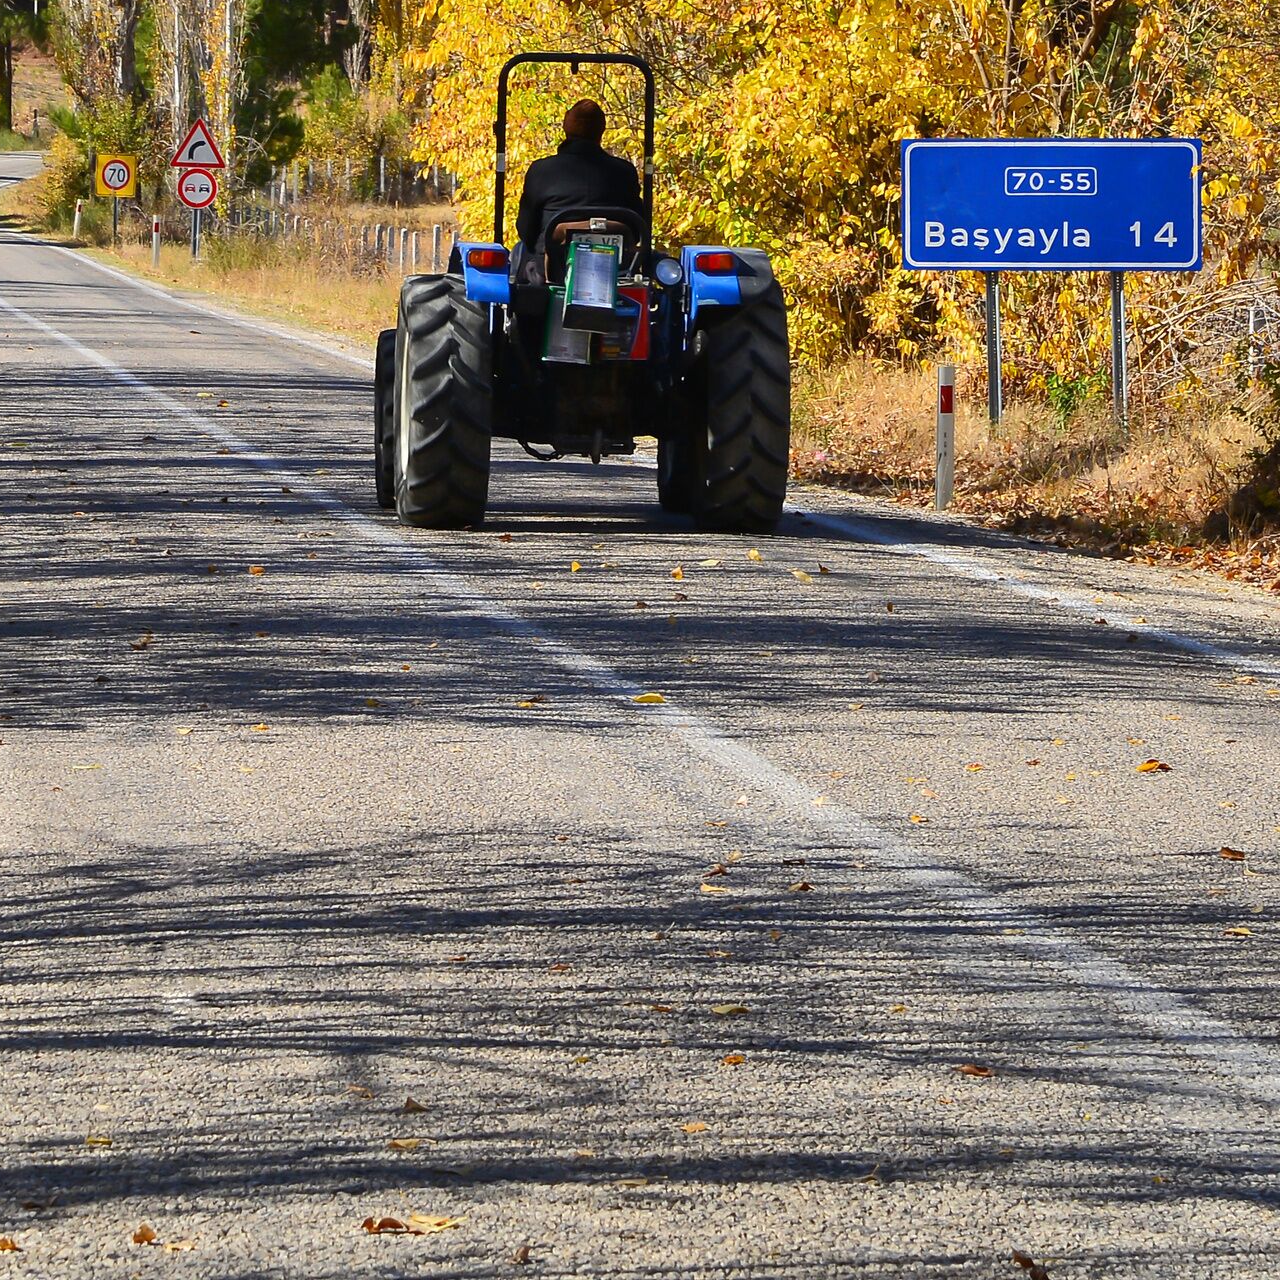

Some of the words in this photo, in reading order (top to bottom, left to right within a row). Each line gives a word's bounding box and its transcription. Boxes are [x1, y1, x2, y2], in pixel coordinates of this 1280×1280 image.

[109, 168, 126, 183] 70
[1011, 172, 1091, 191] 70-55
[924, 221, 1091, 255] Başyayla
[1129, 221, 1178, 248] 14
